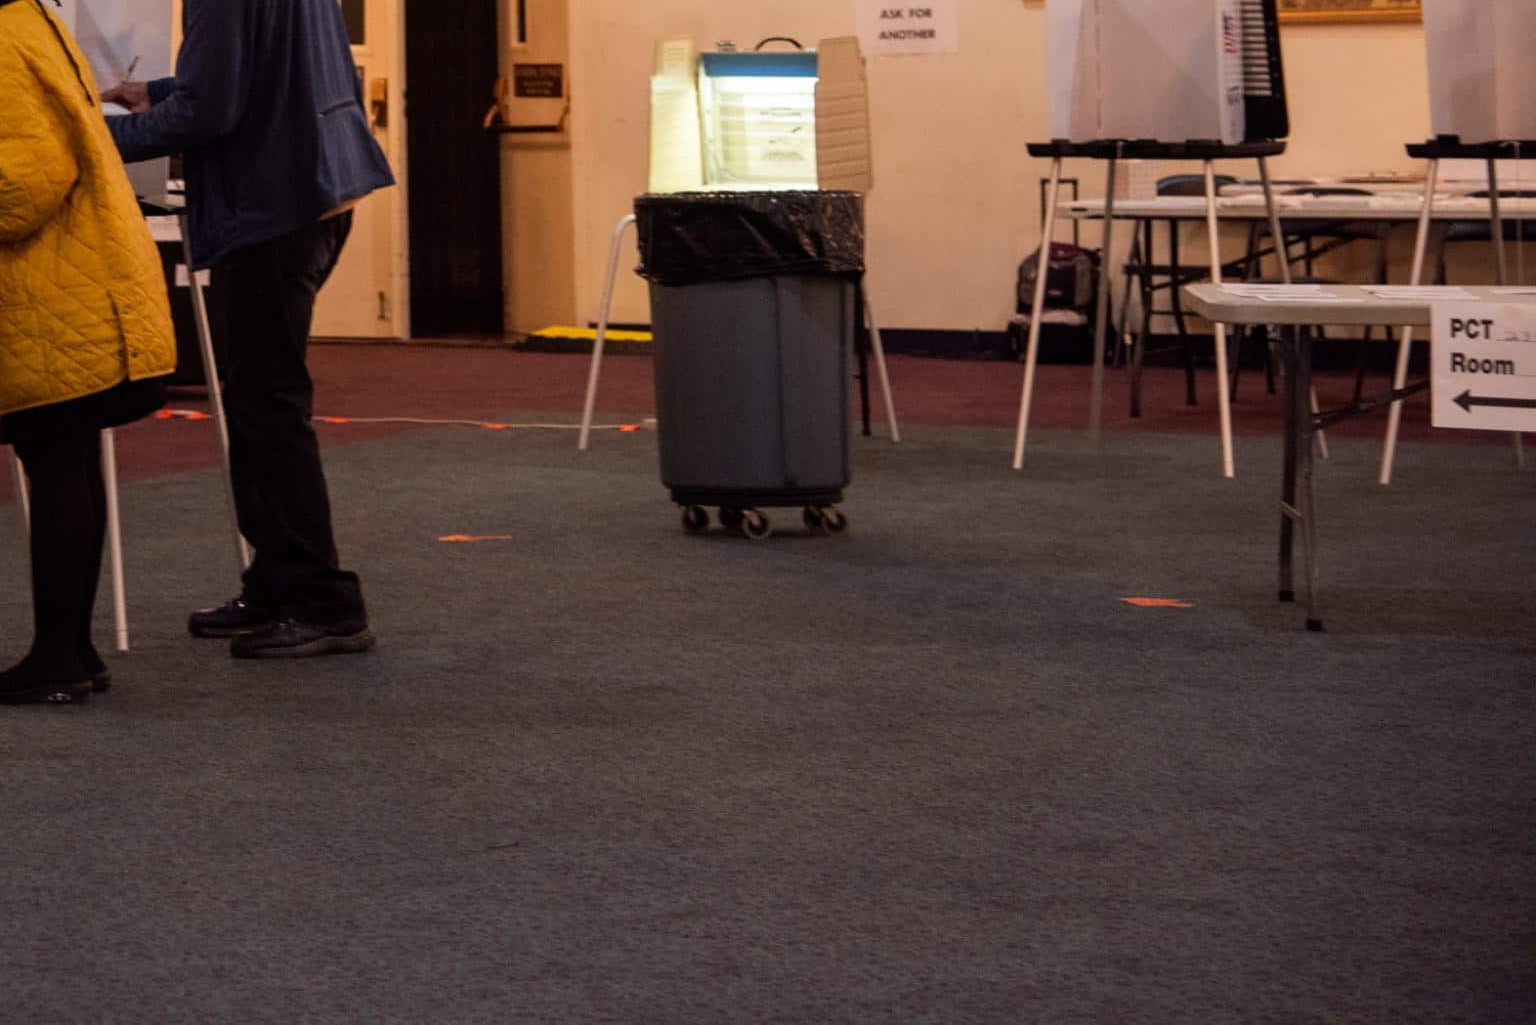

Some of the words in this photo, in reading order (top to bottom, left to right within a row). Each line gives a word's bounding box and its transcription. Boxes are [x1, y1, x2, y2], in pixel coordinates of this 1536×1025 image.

[880, 9, 904, 18] ASK
[909, 8, 932, 18] FOR
[879, 29, 935, 39] ANOTHER
[1450, 318, 1493, 339] PCT
[1450, 352, 1514, 375] Room
